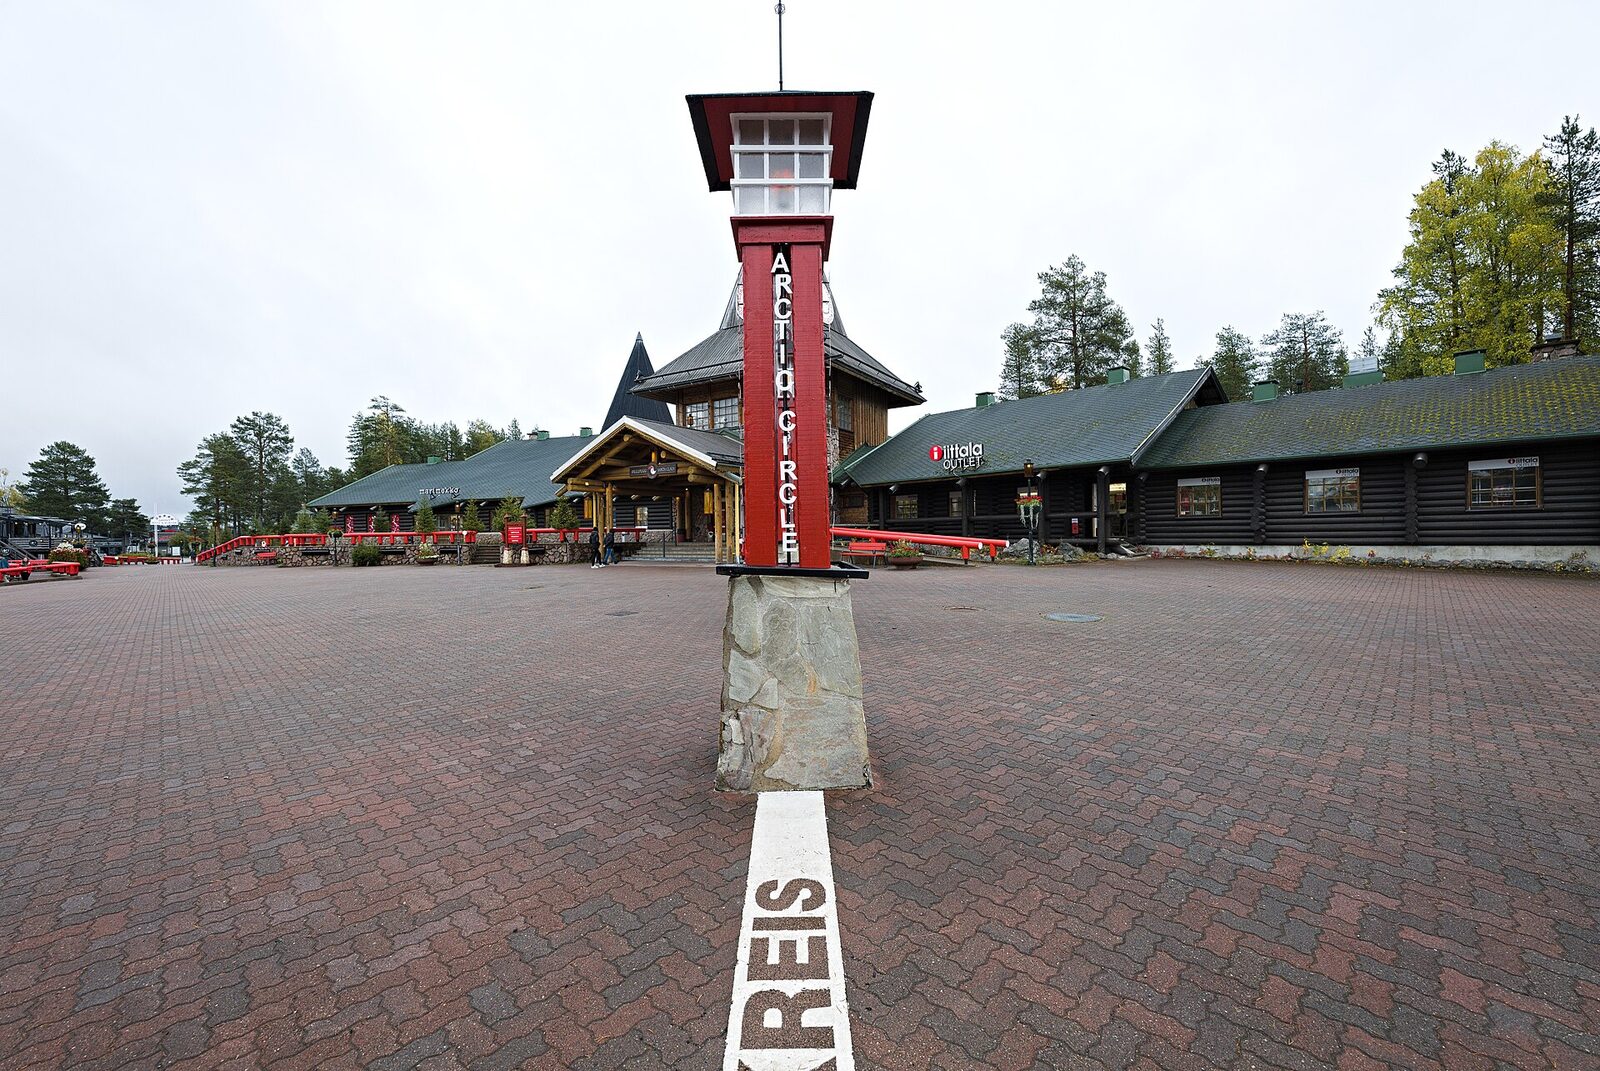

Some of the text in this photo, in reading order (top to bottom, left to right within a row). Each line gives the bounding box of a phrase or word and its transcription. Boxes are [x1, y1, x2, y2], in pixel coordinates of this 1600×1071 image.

[771, 252, 797, 553] ARCTIC CIRCLE
[943, 441, 984, 460] iittala
[943, 456, 983, 470] OUTLET
[737, 877, 837, 1071] REIS
